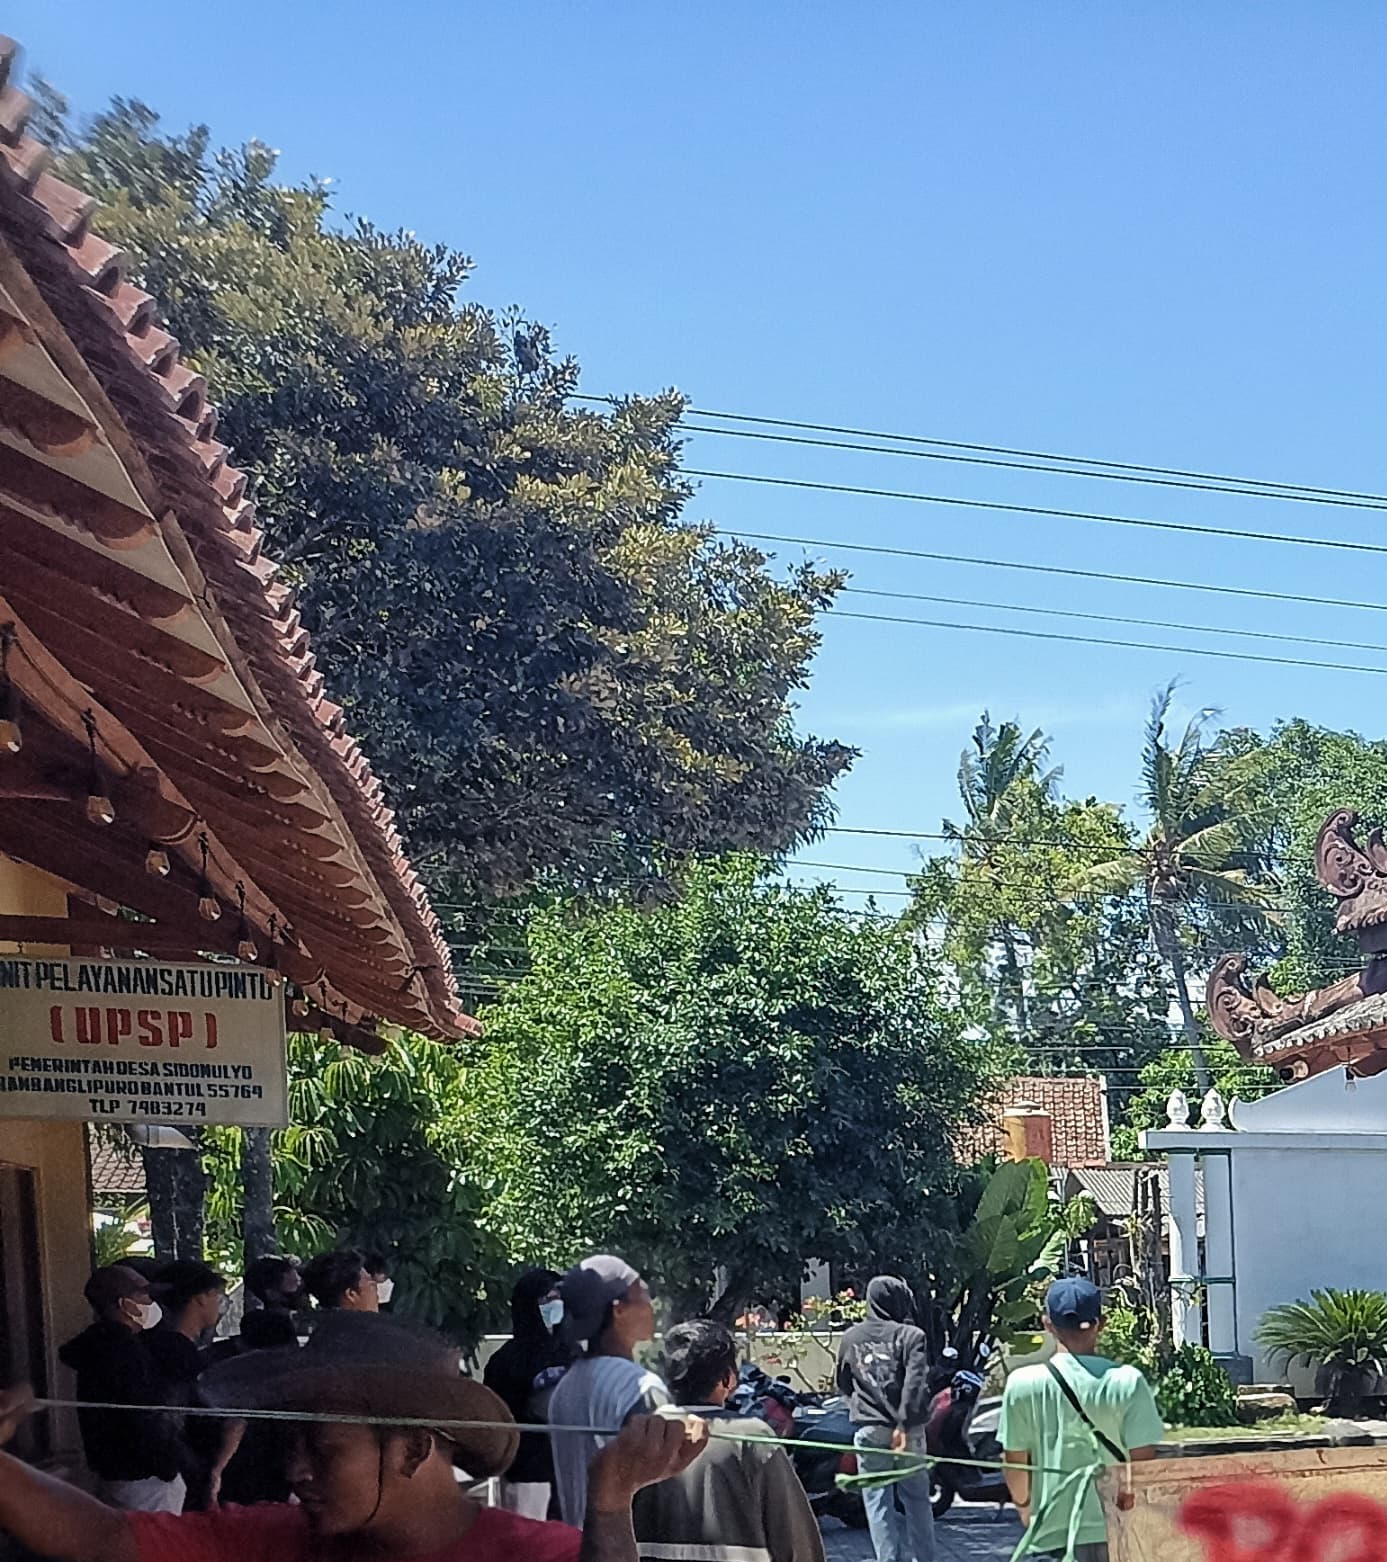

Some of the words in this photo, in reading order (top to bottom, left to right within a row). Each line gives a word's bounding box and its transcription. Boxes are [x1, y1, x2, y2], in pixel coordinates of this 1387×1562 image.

[8, 1056, 114, 1075] PEMERINTAH
[116, 1060, 160, 1077] DESA
[162, 1062, 253, 1080] SIDOMULYO
[141, 1080, 204, 1098] BANTUL
[88, 1098, 121, 1115] TLP
